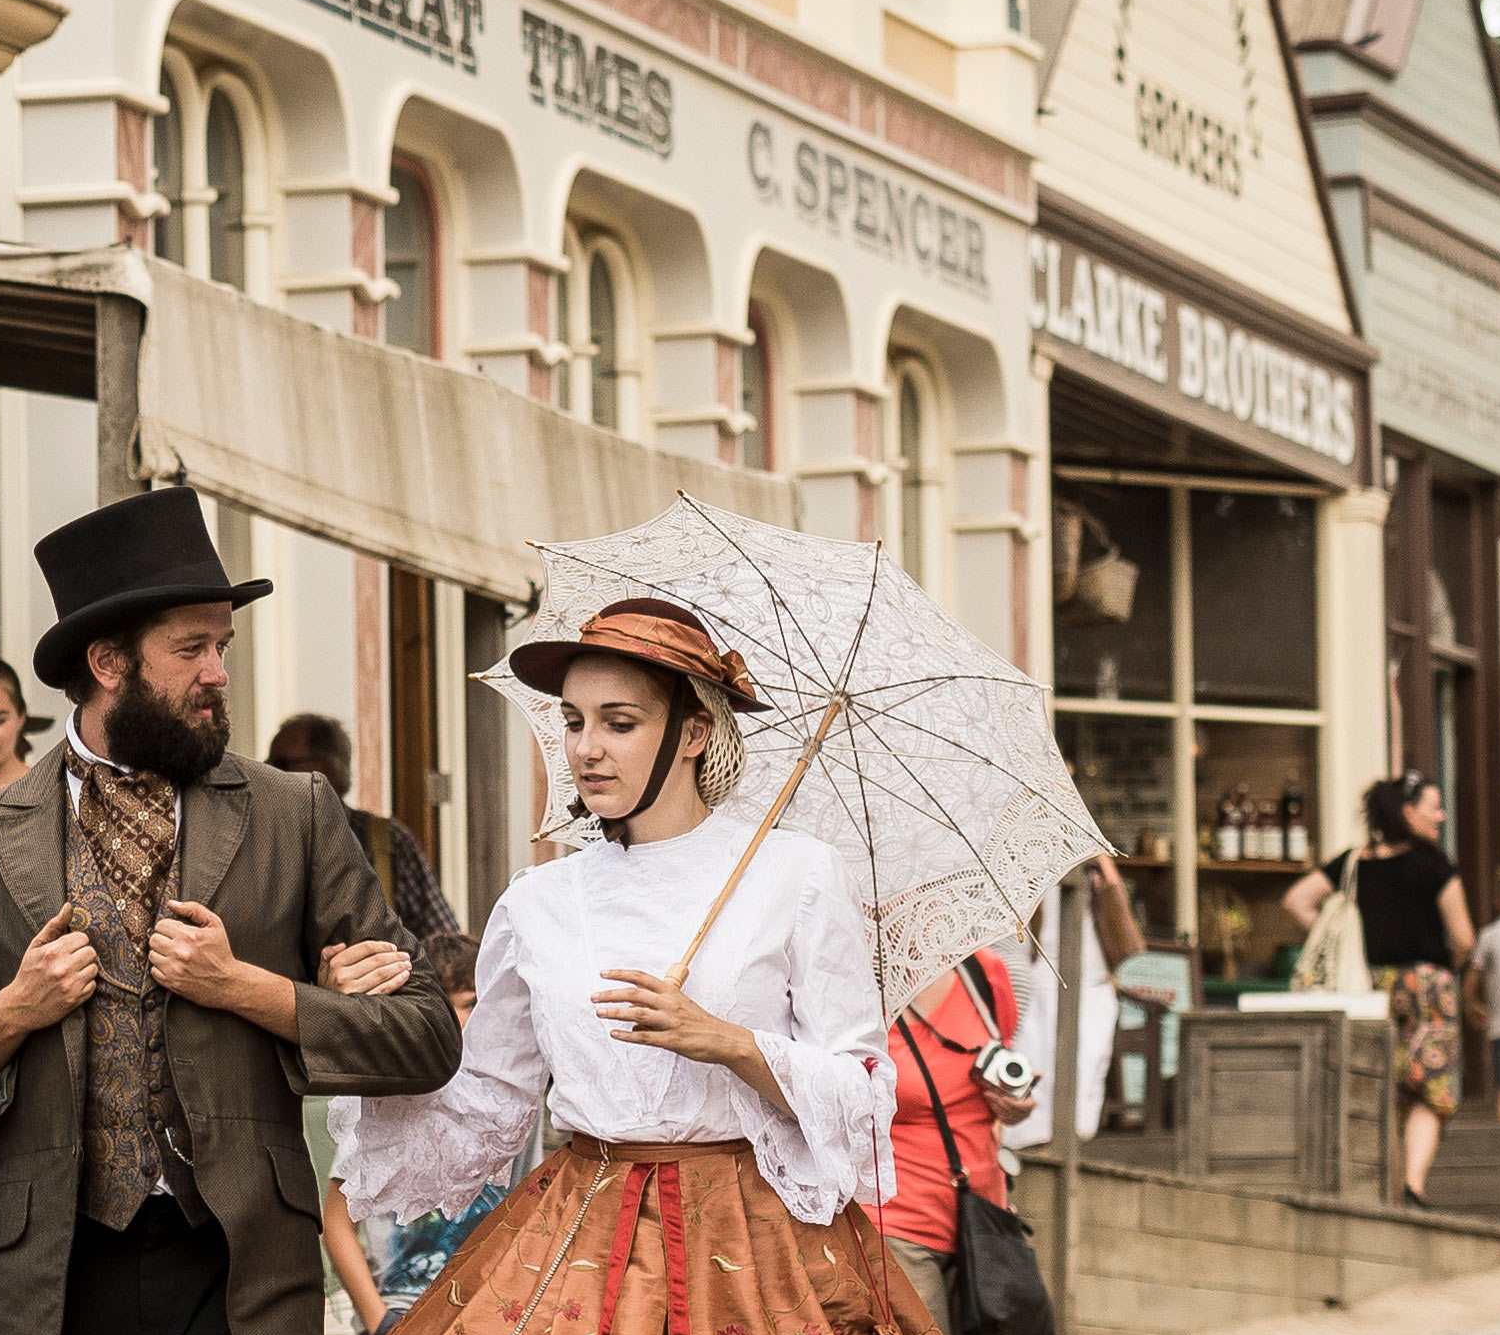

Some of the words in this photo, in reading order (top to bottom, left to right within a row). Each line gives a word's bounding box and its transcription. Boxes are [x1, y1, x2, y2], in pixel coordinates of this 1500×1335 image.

[522, 9, 676, 159] TIMES
[794, 140, 991, 296] SPENCER
[1135, 80, 1242, 200] GROCERS
[1027, 236, 1169, 384] CLARKE
[1178, 303, 1356, 467] BROTHERS
